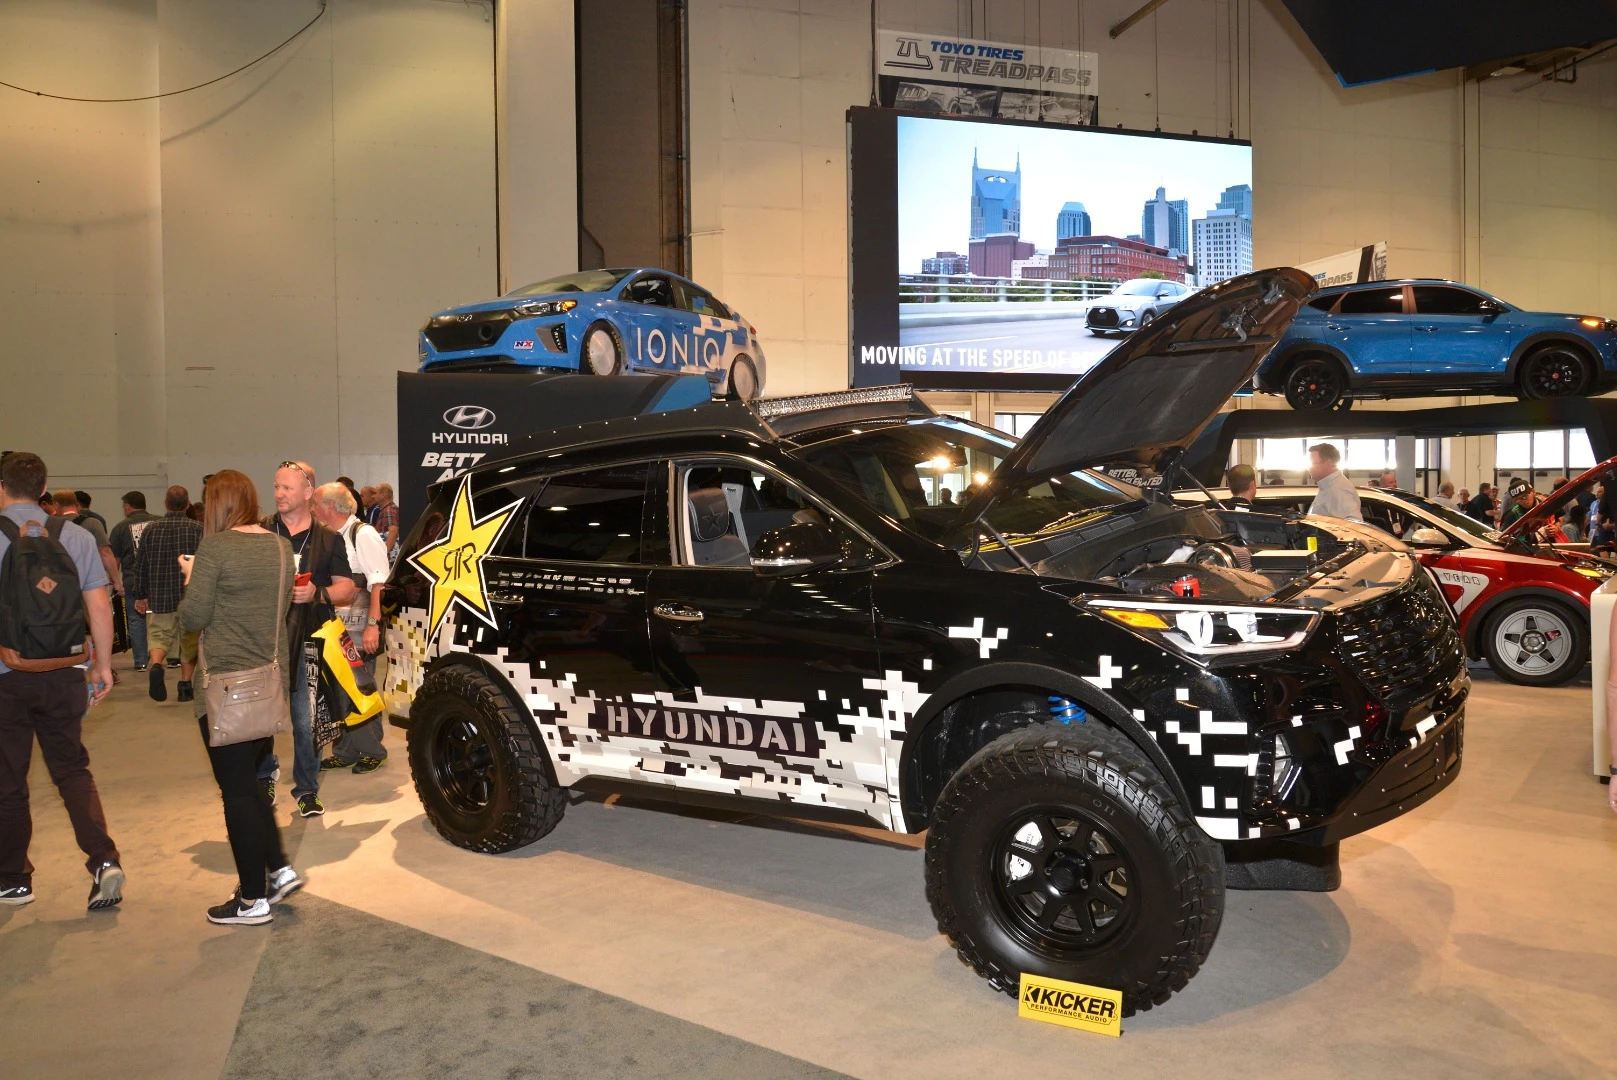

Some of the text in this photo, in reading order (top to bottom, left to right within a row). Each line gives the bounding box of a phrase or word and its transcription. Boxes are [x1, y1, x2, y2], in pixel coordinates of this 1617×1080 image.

[931, 40, 1024, 61] TOYO TIRES
[938, 55, 1092, 87] TREADPASS
[637, 327, 720, 370] IONIQ
[861, 345, 926, 365] MOVING
[932, 347, 950, 366] AT
[957, 348, 987, 367] THE
[992, 349, 1043, 368] SPEED
[432, 432, 508, 445] HYUNDAI
[421, 452, 486, 468] BETT
[1443, 572, 1480, 585] YEAR
[607, 705, 806, 753] HYUNDAI
[1031, 1003, 1107, 1023] PERFORMANCE AUDIO
[1040, 988, 1115, 1018] KICKER
